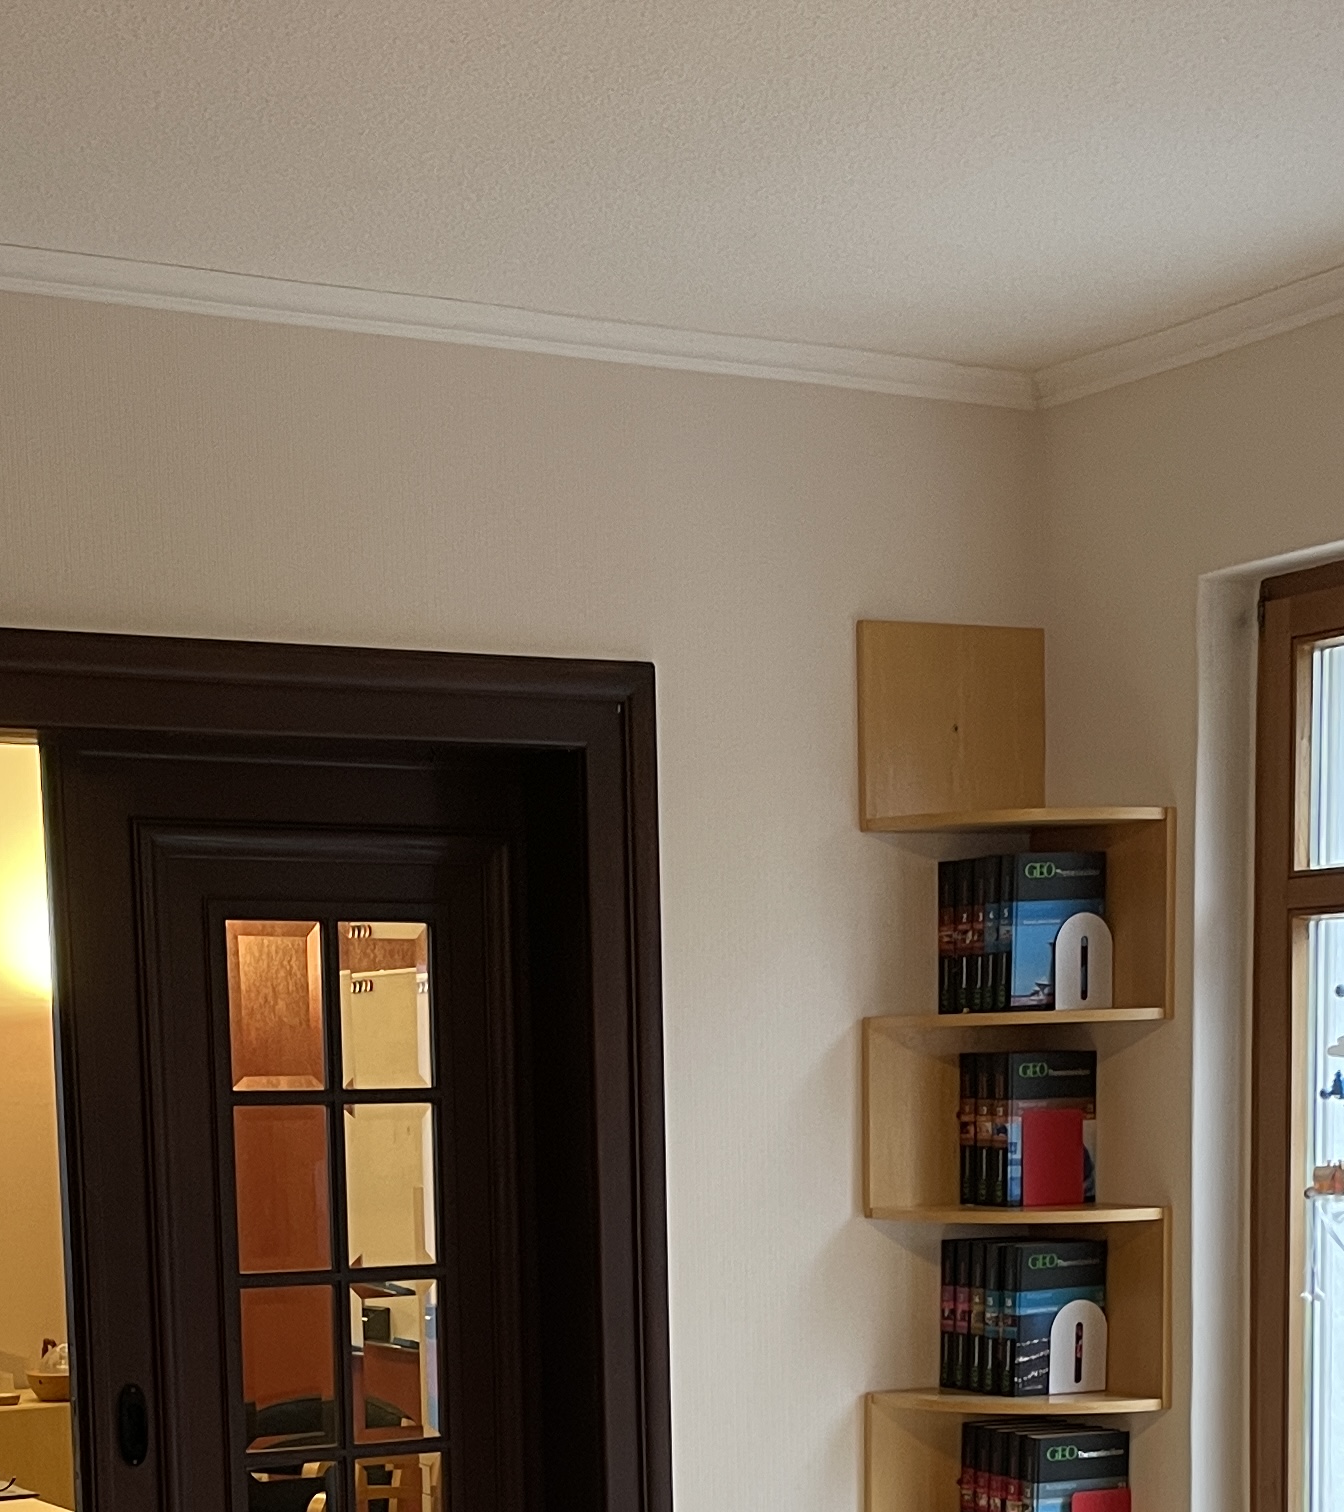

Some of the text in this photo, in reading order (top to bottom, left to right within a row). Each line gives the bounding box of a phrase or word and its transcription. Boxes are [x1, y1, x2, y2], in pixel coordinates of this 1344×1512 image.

[1025, 862, 1055, 878] GEO
[1019, 1062, 1048, 1077] GEO
[1028, 1254, 1057, 1269] GEO
[1047, 1445, 1078, 1461] GEO
